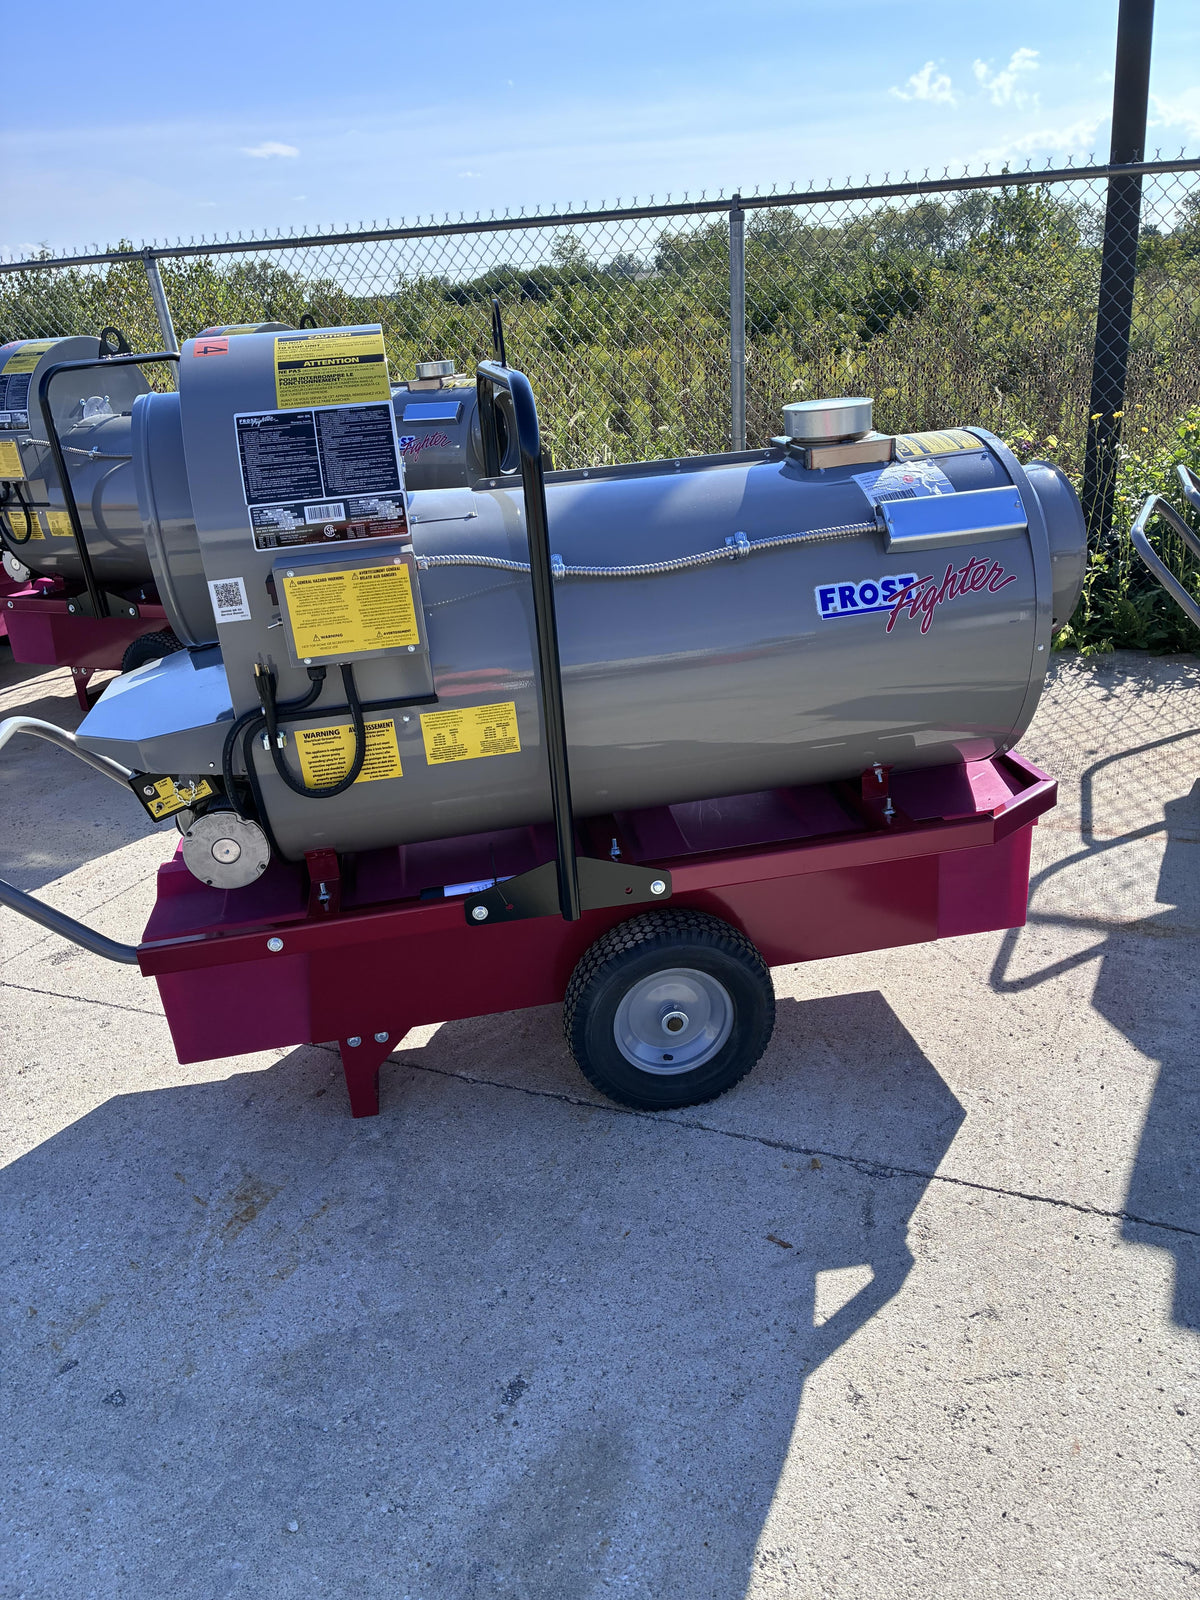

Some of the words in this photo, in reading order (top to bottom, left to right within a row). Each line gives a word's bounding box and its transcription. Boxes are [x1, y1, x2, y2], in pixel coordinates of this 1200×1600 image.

[304, 357, 359, 367] ATTENTION
[280, 377, 340, 386] FONCTIONNEMENT
[402, 432, 452, 462] Fighter
[818, 576, 914, 612] FROST
[886, 556, 1016, 634] Fighter
[303, 729, 340, 739] WARNING
